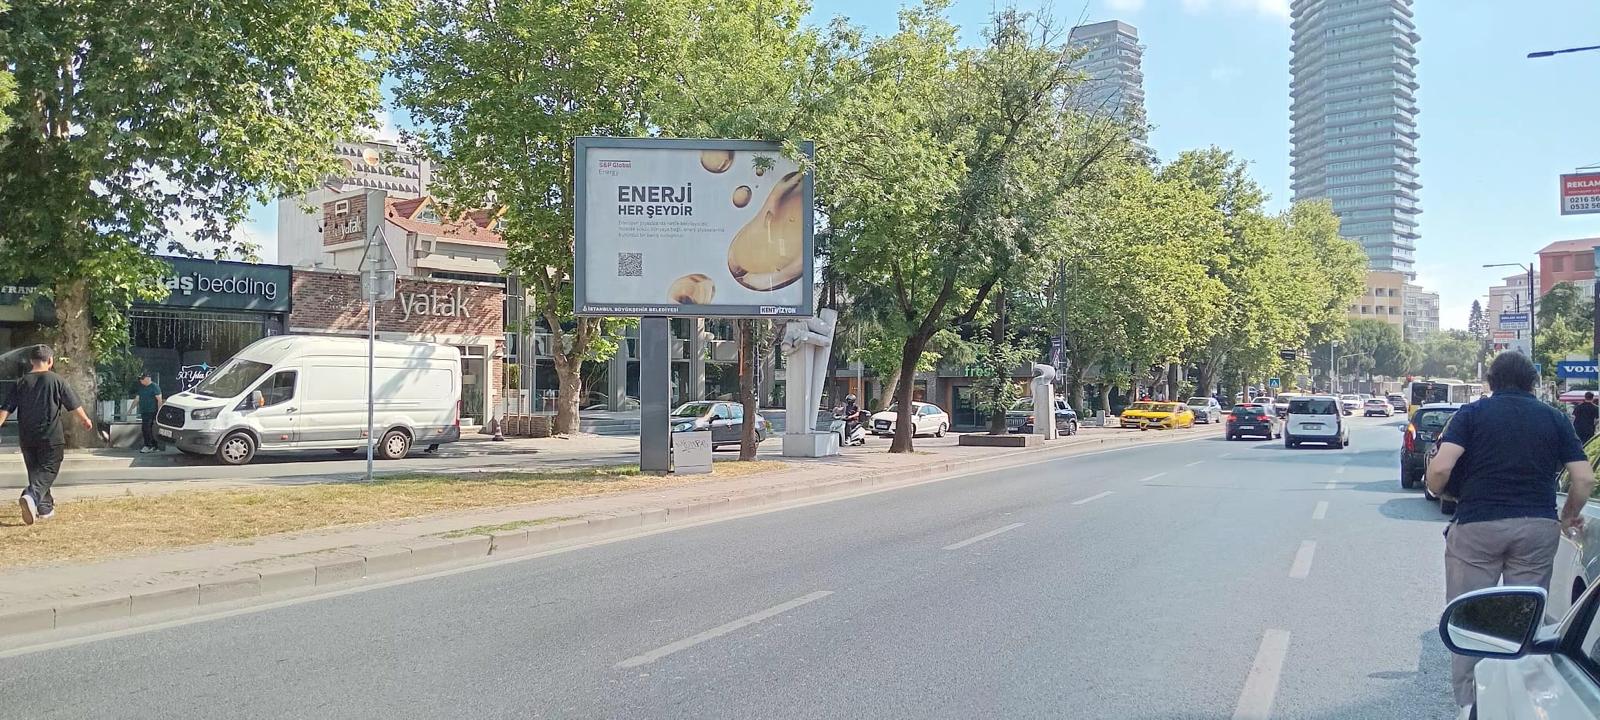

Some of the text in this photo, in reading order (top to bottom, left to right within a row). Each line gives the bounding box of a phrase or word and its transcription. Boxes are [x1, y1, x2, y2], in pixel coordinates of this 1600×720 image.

[618, 182, 692, 203] ENERJİ
[618, 203, 692, 219] HER ŞEYDİR
[198, 273, 277, 300] bedding
[399, 287, 470, 322] yatak
